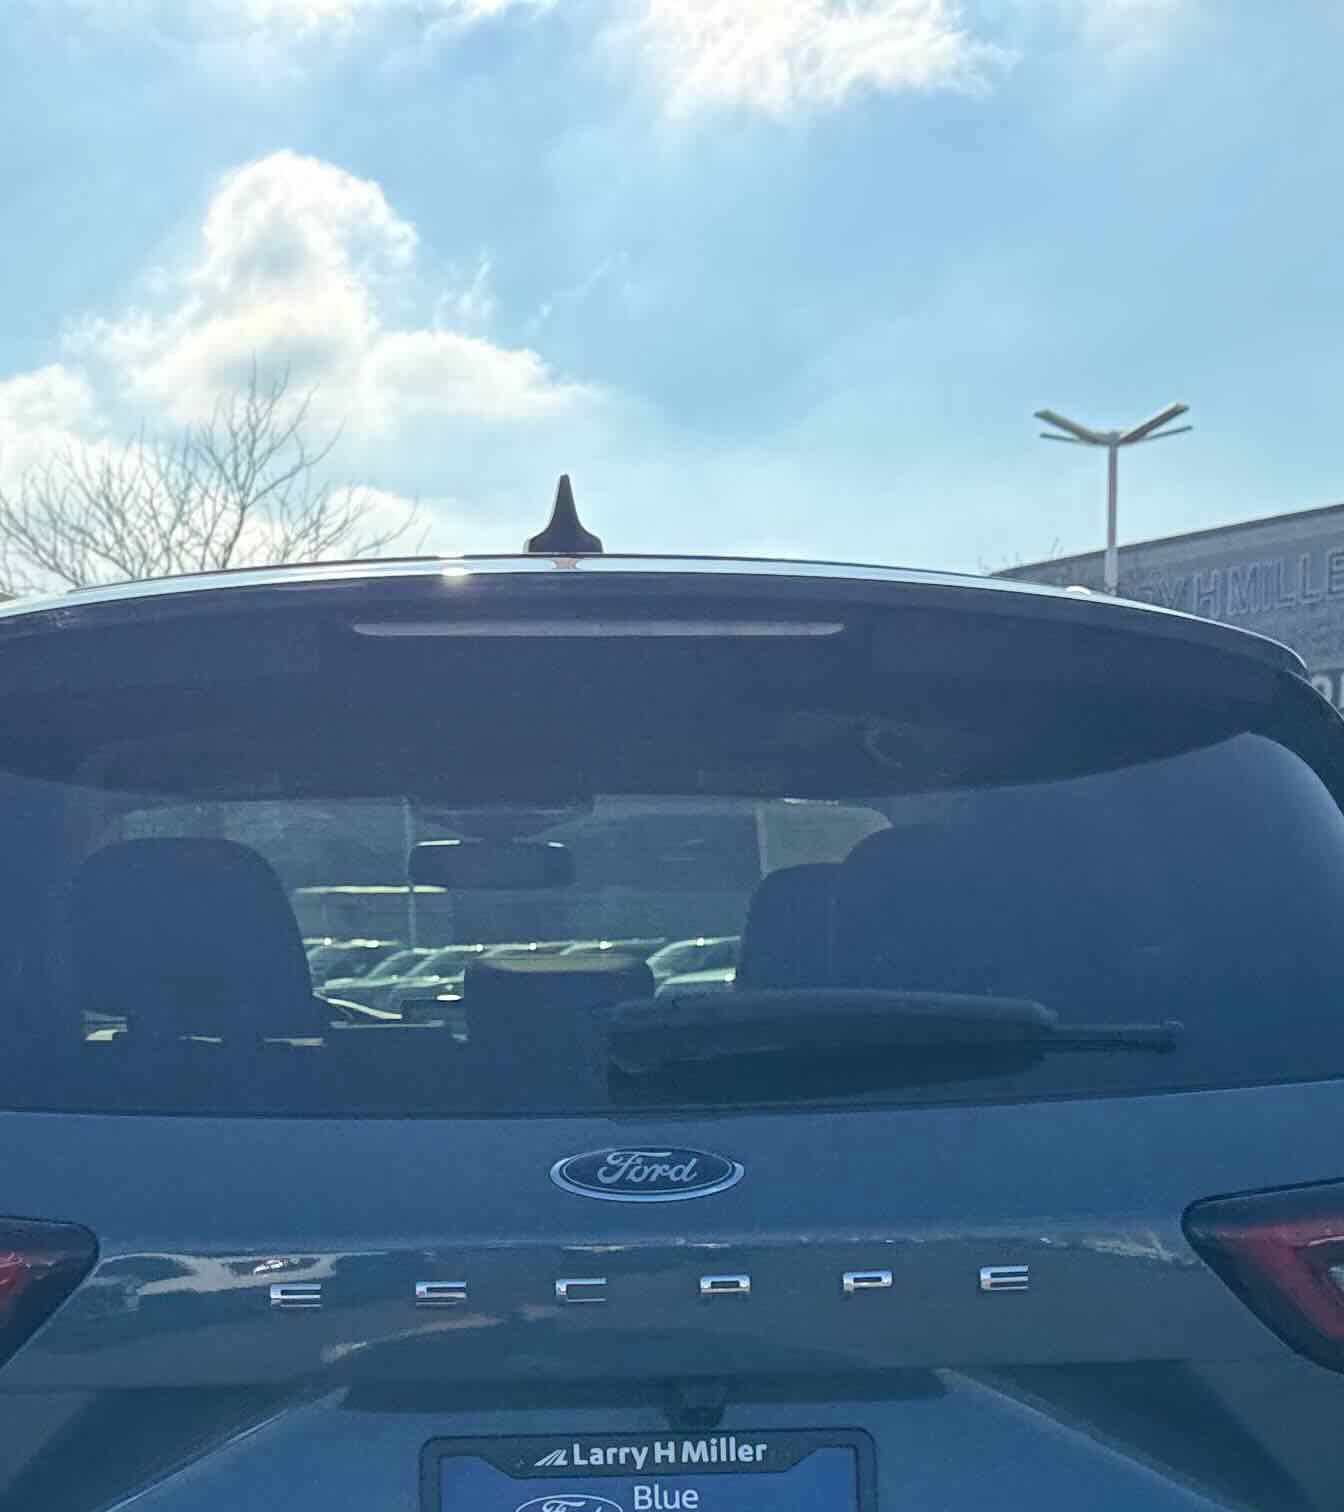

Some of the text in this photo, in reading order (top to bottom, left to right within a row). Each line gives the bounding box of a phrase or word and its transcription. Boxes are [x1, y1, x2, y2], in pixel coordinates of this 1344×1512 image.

[597, 1151, 699, 1184] Ford
[269, 1264, 1030, 1309] ESCAPE
[573, 1437, 767, 1470] Larry H Miller
[634, 1484, 698, 1510] Blue
